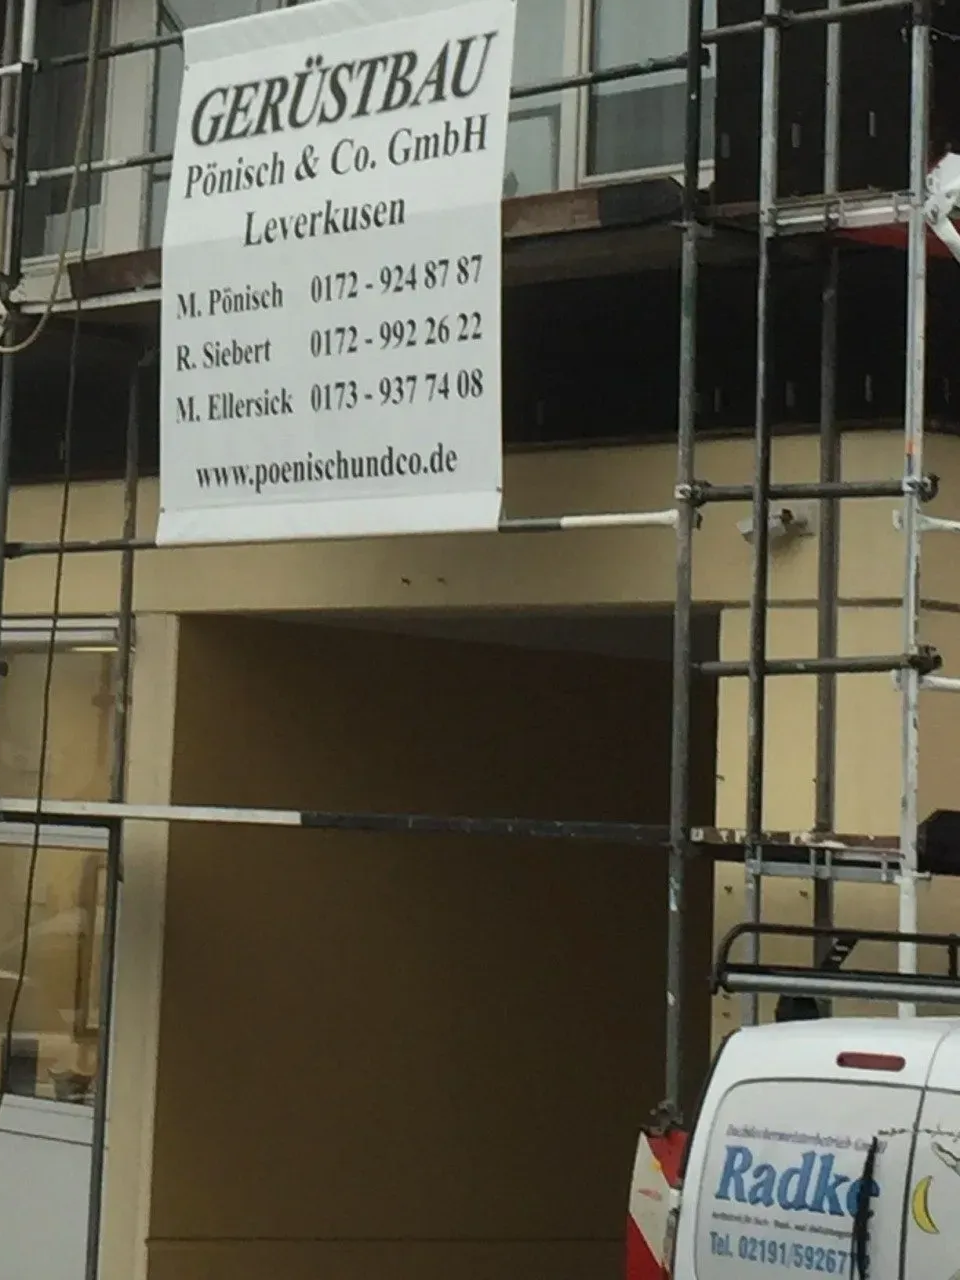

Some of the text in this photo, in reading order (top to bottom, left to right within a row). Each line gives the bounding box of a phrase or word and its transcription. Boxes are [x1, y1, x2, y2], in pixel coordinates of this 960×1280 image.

[191, 30, 498, 147] GERÜSTBAU
[184, 114, 488, 199] Pönisch & Co. GmbH
[243, 198, 406, 248] Leverkusen
[176, 293, 202, 320] M.
[209, 281, 284, 316] Pönisch
[311, 271, 358, 303] 0172
[176, 345, 197, 372] R.
[203, 338, 271, 369] Siebert
[311, 325, 358, 358] 0172
[176, 396, 201, 424] M.
[208, 387, 294, 421] Ellersick
[311, 380, 358, 412] 0173
[196, 443, 458, 494] www.poenischundco.de
[714, 1145, 881, 1218] Radke
[709, 1230, 868, 1276] Tel. 02191/59267
